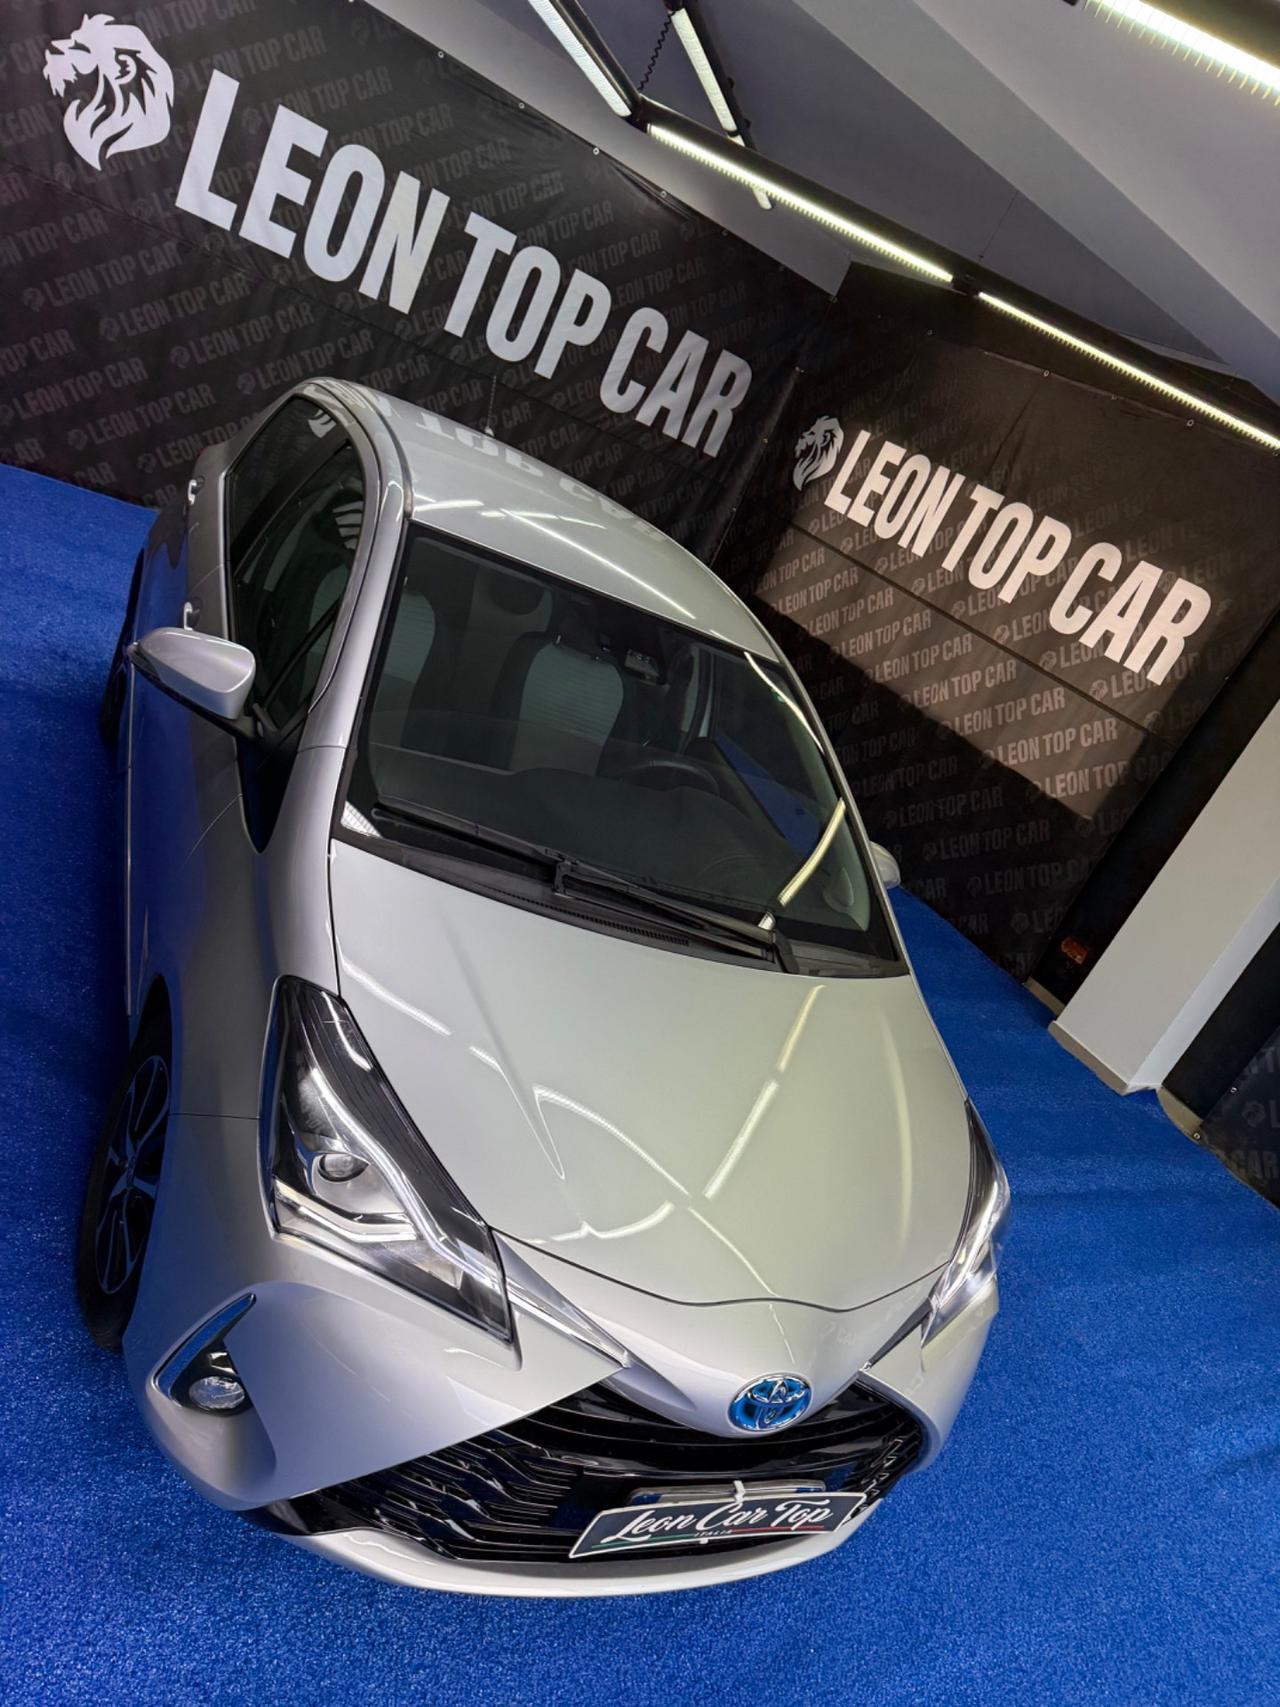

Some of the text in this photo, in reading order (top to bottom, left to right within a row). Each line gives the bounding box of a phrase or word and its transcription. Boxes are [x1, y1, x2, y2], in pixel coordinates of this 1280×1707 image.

[240, 37, 280, 75] TOP
[283, 25, 327, 62] CAR
[312, 65, 393, 113] TOP CAR
[376, 116, 414, 148] TOP
[416, 103, 454, 137] CAR
[438, 150, 473, 182] TOP
[0, 173, 30, 206] AR
[494, 181, 528, 212] TOP
[530, 169, 565, 202] CAR
[15, 222, 60, 257] TOP
[61, 207, 110, 243] CAR
[547, 212, 579, 243] TOP
[580, 199, 614, 231] CAR
[175, 68, 752, 458] LEON TOP CAR
[598, 241, 628, 271] TOP
[629, 229, 662, 259] CAR
[42, 268, 101, 308] LEON
[96, 255, 137, 288] TOP
[138, 240, 183, 275] CAR
[644, 268, 673, 296] TOP
[675, 256, 705, 285] CAR
[119, 271, 251, 337] LEON TOP CAR
[29, 328, 76, 361] CAR
[188, 301, 315, 364] LEON TOP CAR
[465, 335, 488, 361] LE
[255, 328, 375, 390] LEON TOP CAR
[395, 354, 431, 385] CAR
[12, 357, 149, 420] LEON TOP CAR
[450, 378, 484, 408] CAR
[87, 383, 216, 445] LEON TOP CAR
[501, 401, 532, 429] CAR
[155, 433, 203, 469] LEON
[549, 423, 580, 450] CAR
[594, 443, 623, 470] CAR
[821, 509, 848, 532] LEO
[778, 560, 800, 583] TOP
[801, 547, 825, 573] CAR
[824, 429, 967, 557] LEON
[941, 483, 1072, 604] TOP
[1049, 542, 1212, 686] CAR
[778, 566, 859, 615] LEON TOP CAR
[809, 587, 894, 636] LEON TOP CAR
[841, 609, 932, 658] LEON TOP CAR
[875, 633, 973, 683] LEON TOP CAR
[913, 658, 1017, 708] LEON TOP CAR
[954, 686, 1066, 736] LEON TOP CAR
[997, 717, 1118, 767] LEON TOP CAR
[896, 763, 925, 789] TOP
[928, 756, 958, 781] CAR
[1044, 767, 1090, 799] LEON
[900, 786, 1004, 828] LEON TOP CAR
[940, 818, 1051, 860] LEON TOP CAR
[984, 862, 1063, 895] LEON TOP
[600, 1498, 834, 1544] Leon Car Top
